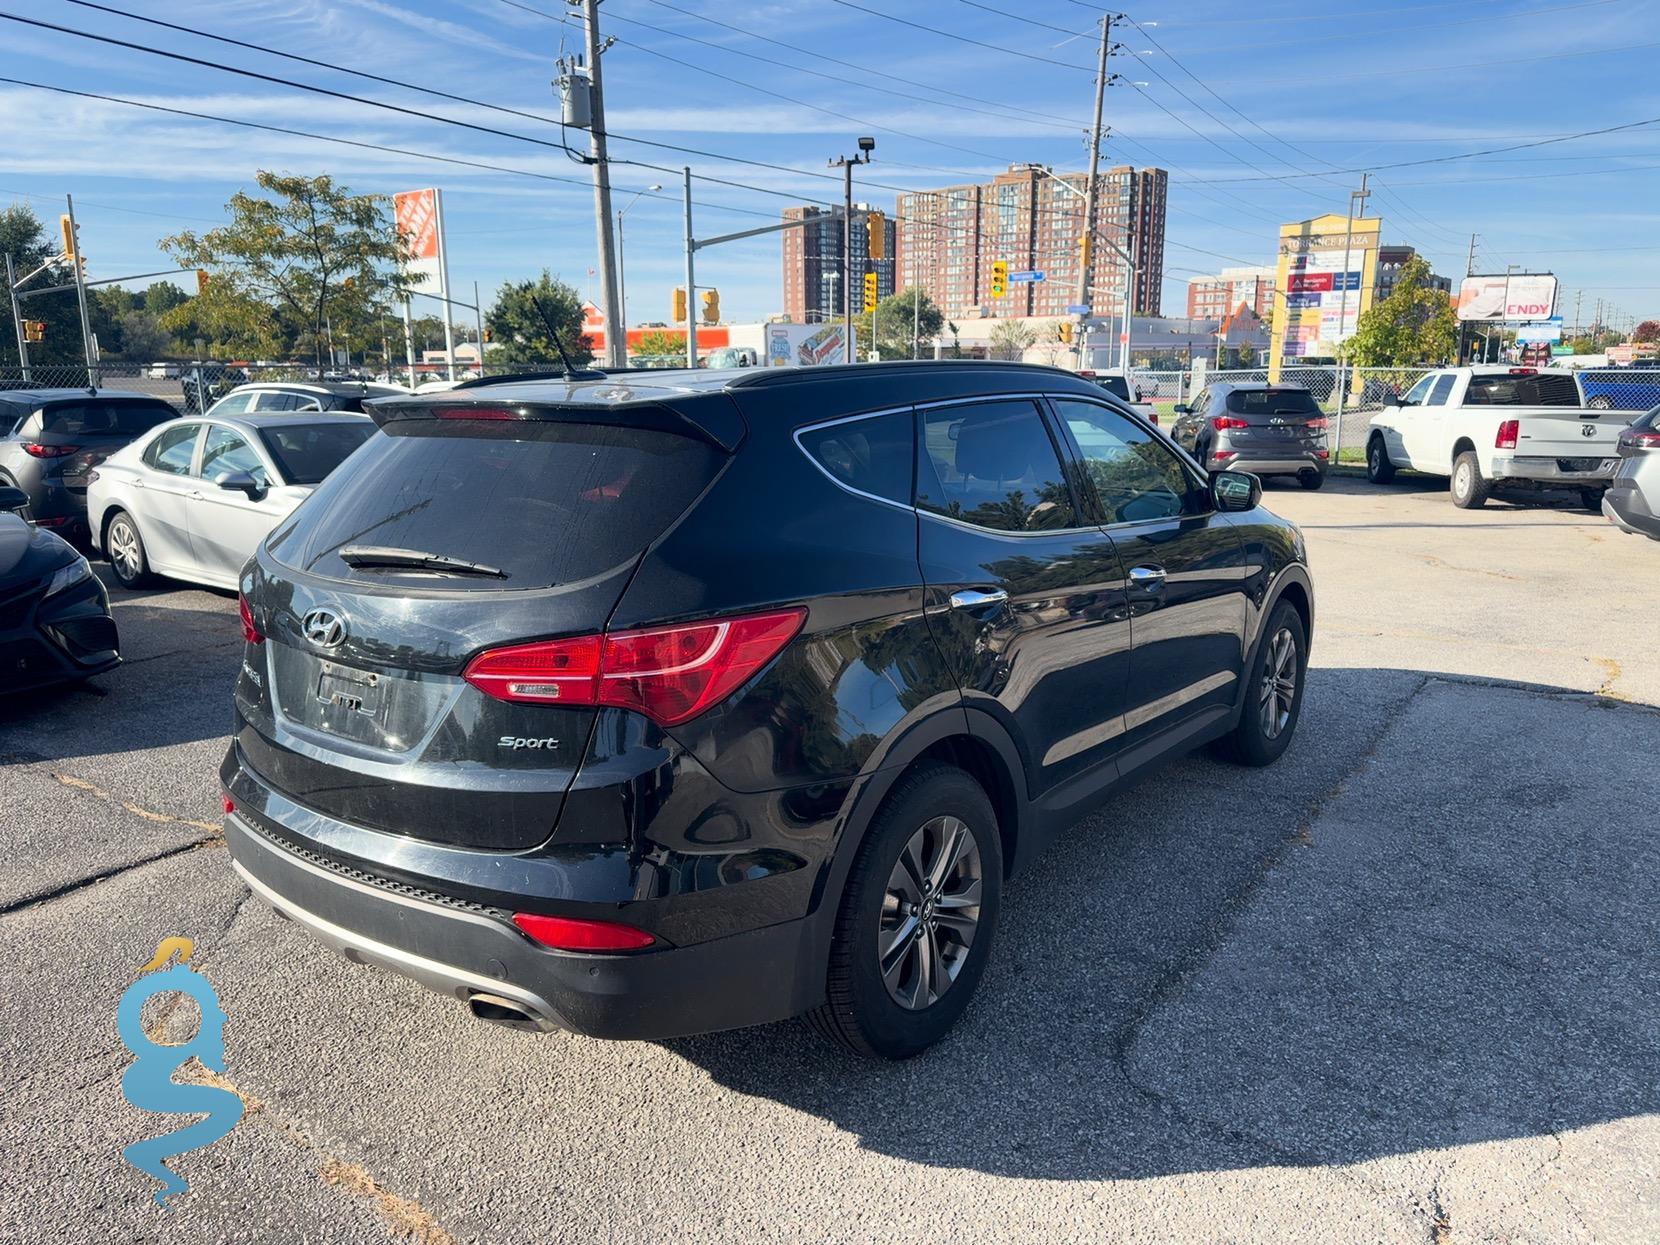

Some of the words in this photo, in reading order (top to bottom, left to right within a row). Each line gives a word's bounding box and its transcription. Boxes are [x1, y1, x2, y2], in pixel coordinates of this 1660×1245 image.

[1287, 237, 1335, 249] TORRANCE
[1507, 304, 1549, 315] ENDY
[497, 736, 559, 750] Sport
